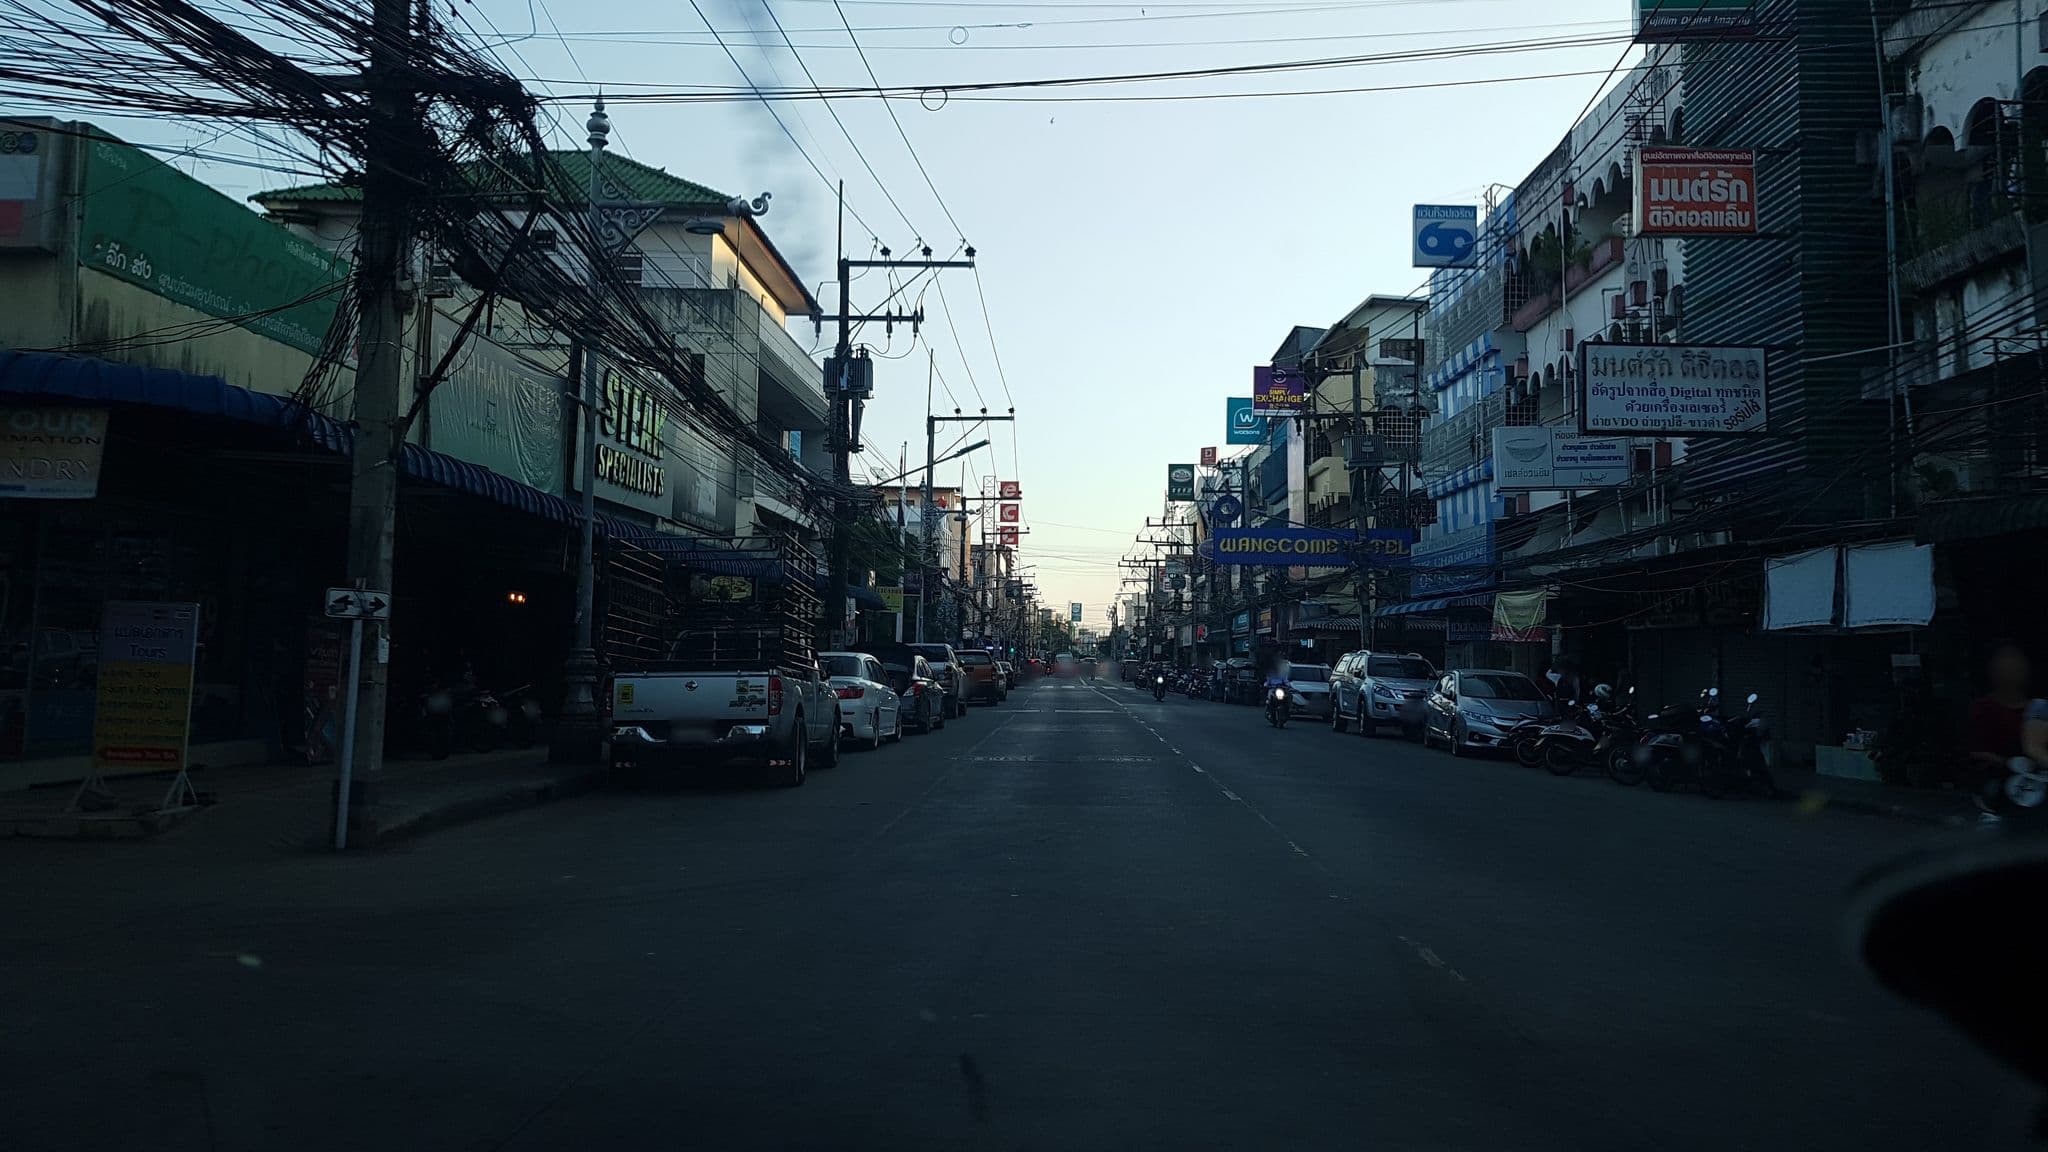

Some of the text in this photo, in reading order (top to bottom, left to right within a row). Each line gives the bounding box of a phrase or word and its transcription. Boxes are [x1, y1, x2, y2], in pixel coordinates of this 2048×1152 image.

[1643, 16, 1678, 27] Fujifilm
[1680, 15, 1711, 25] Digital
[1650, 170, 1748, 203] มนต์รัก
[1648, 203, 1751, 228] ดิจิตอลแล็บ
[1670, 386, 1712, 400] Digital
[604, 369, 668, 459] STEAK
[598, 443, 665, 498] SPECIALISTS
[1219, 538, 1338, 554] WANGCOME
